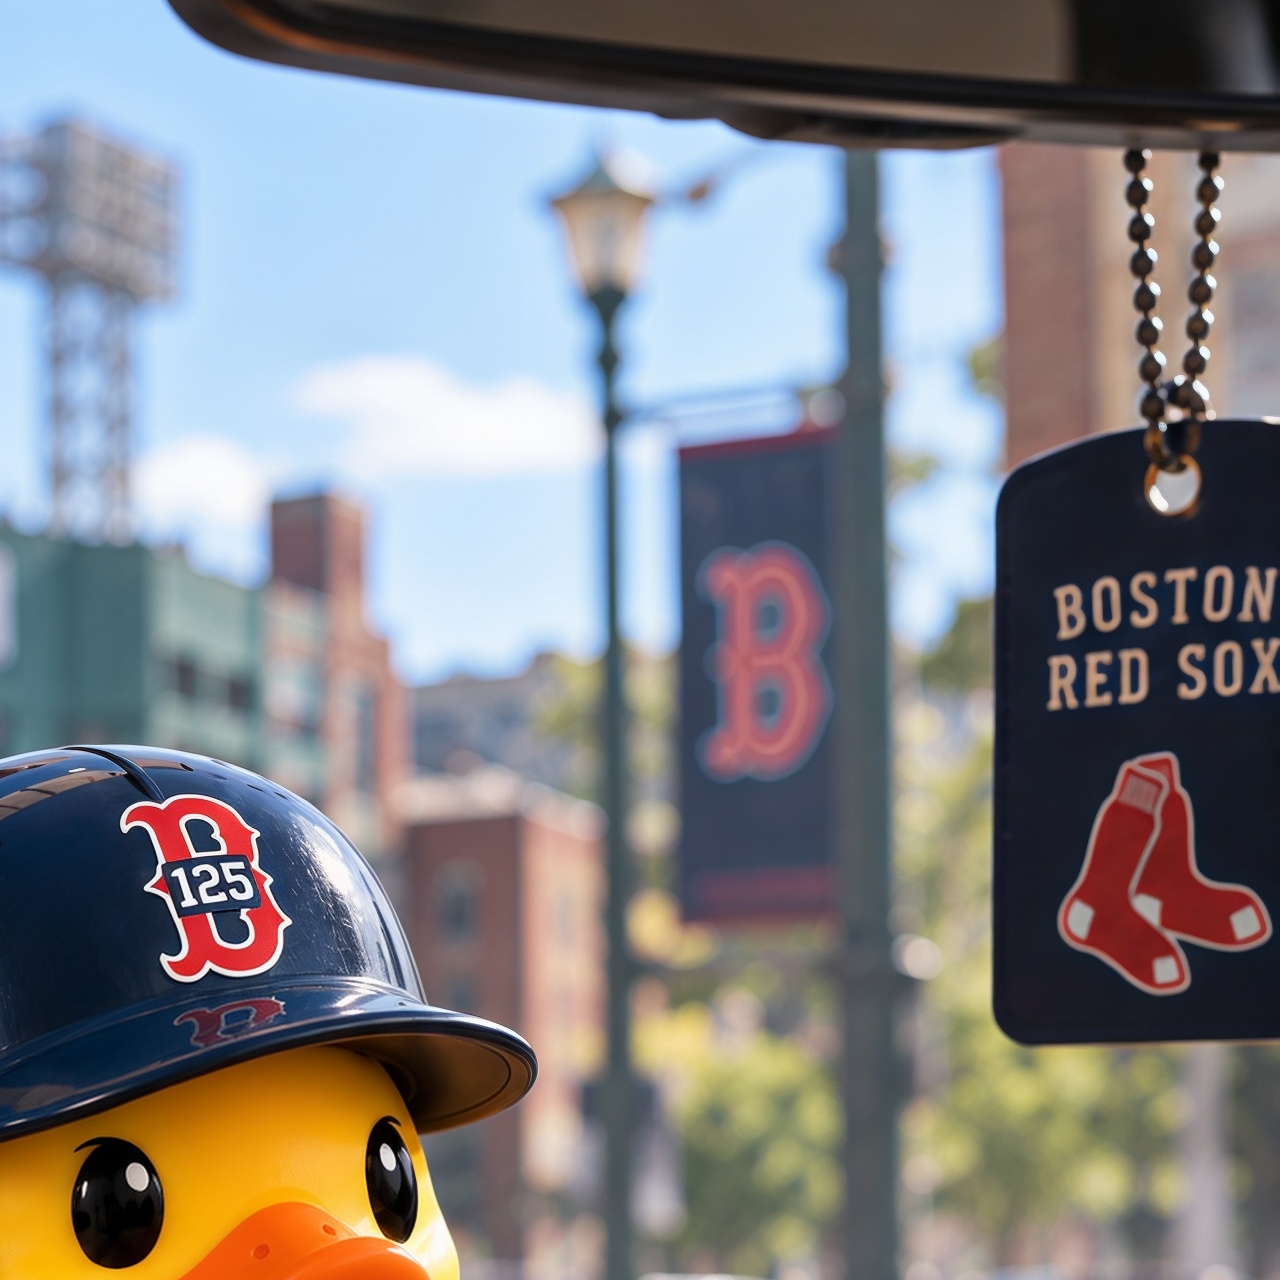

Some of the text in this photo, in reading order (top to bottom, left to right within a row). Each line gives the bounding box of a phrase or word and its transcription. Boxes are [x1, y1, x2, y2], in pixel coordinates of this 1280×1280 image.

[1052, 565, 1279, 642] BOSTON
[699, 541, 830, 782] B
[1045, 637, 1280, 712] RED SOX
[170, 861, 254, 908] 125
